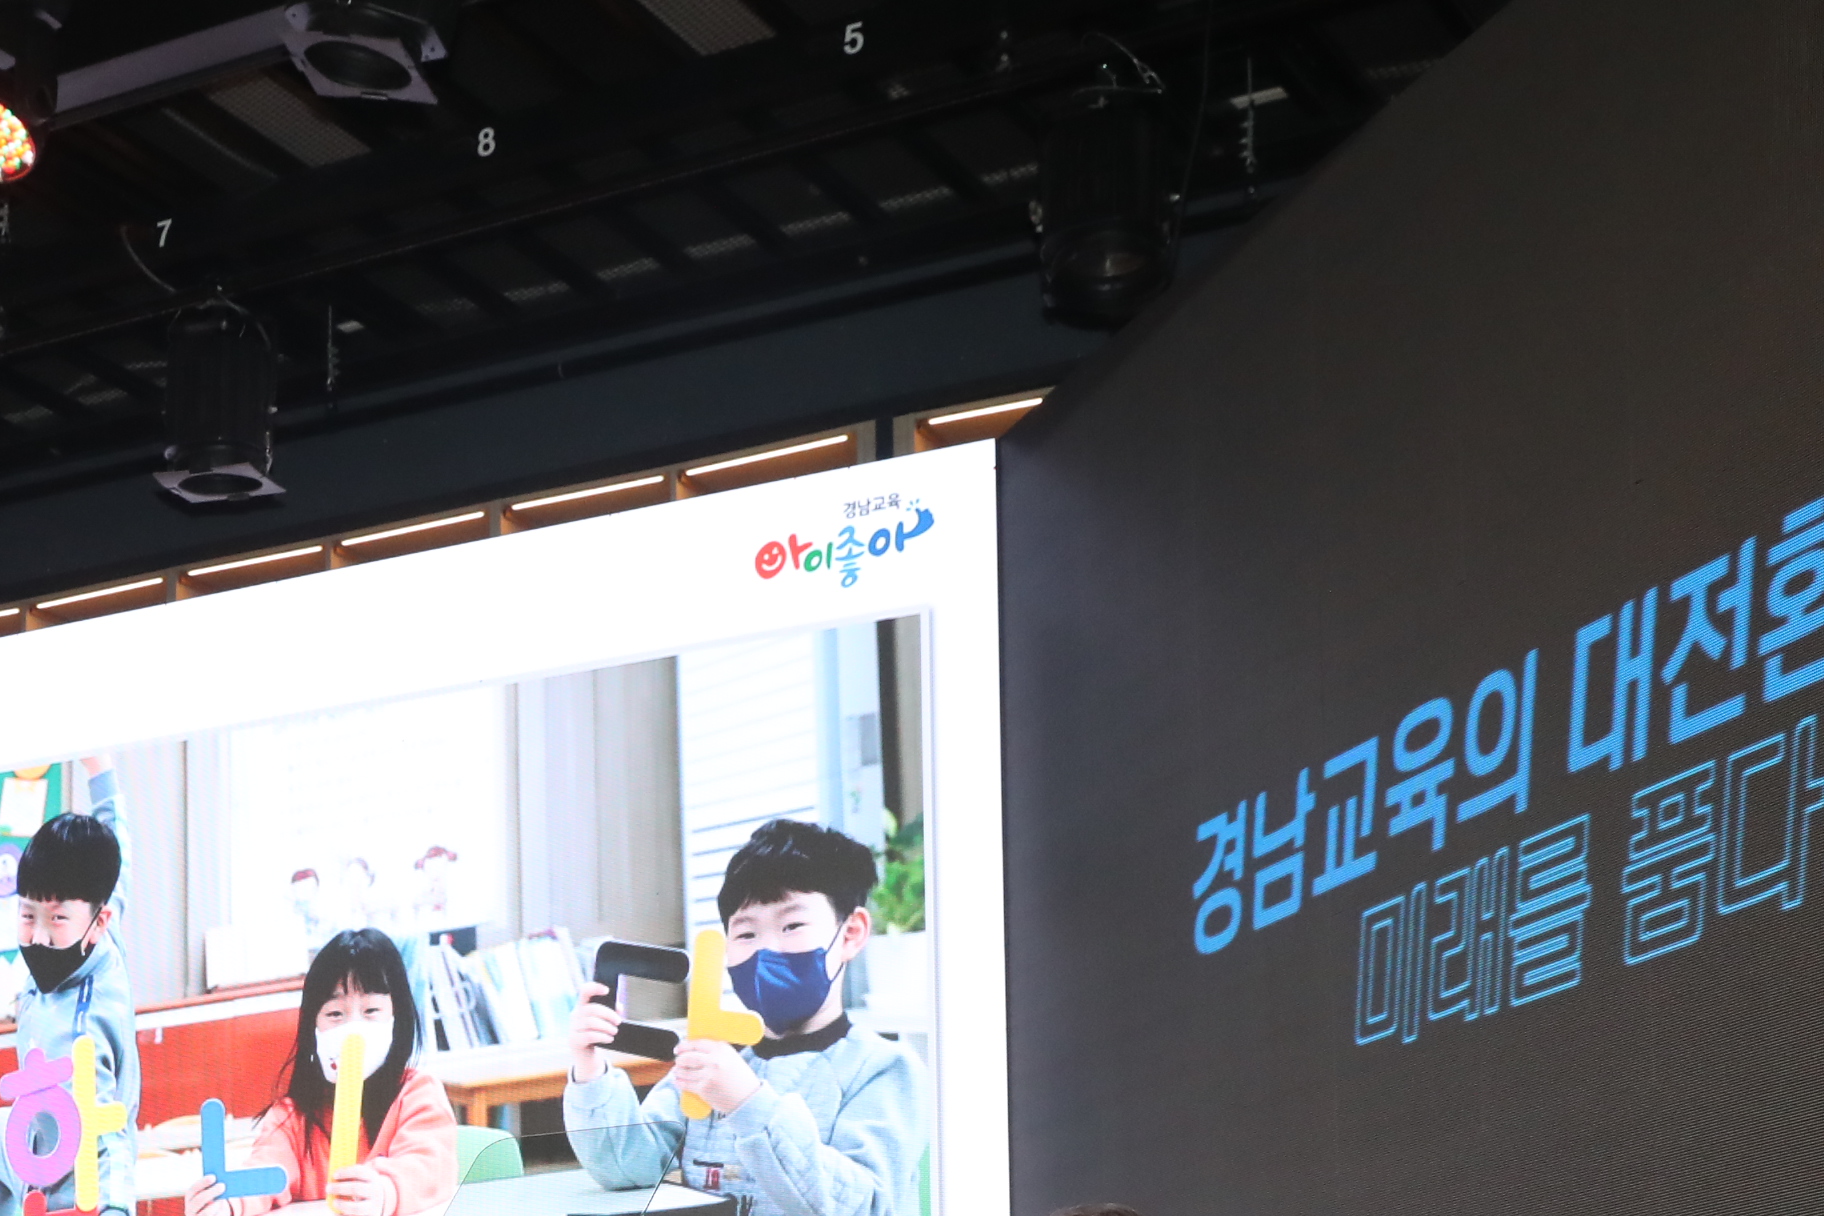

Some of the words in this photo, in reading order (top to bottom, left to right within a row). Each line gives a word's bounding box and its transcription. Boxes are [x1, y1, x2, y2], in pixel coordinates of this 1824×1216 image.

[843, 22, 864, 56] 5
[477, 127, 496, 158] 8
[155, 218, 173, 248] 7
[842, 493, 902, 519] 경남교육
[755, 508, 935, 588] 아이좋아
[1192, 647, 1539, 955] 경남교육의
[1355, 812, 1591, 1045] 미래를
